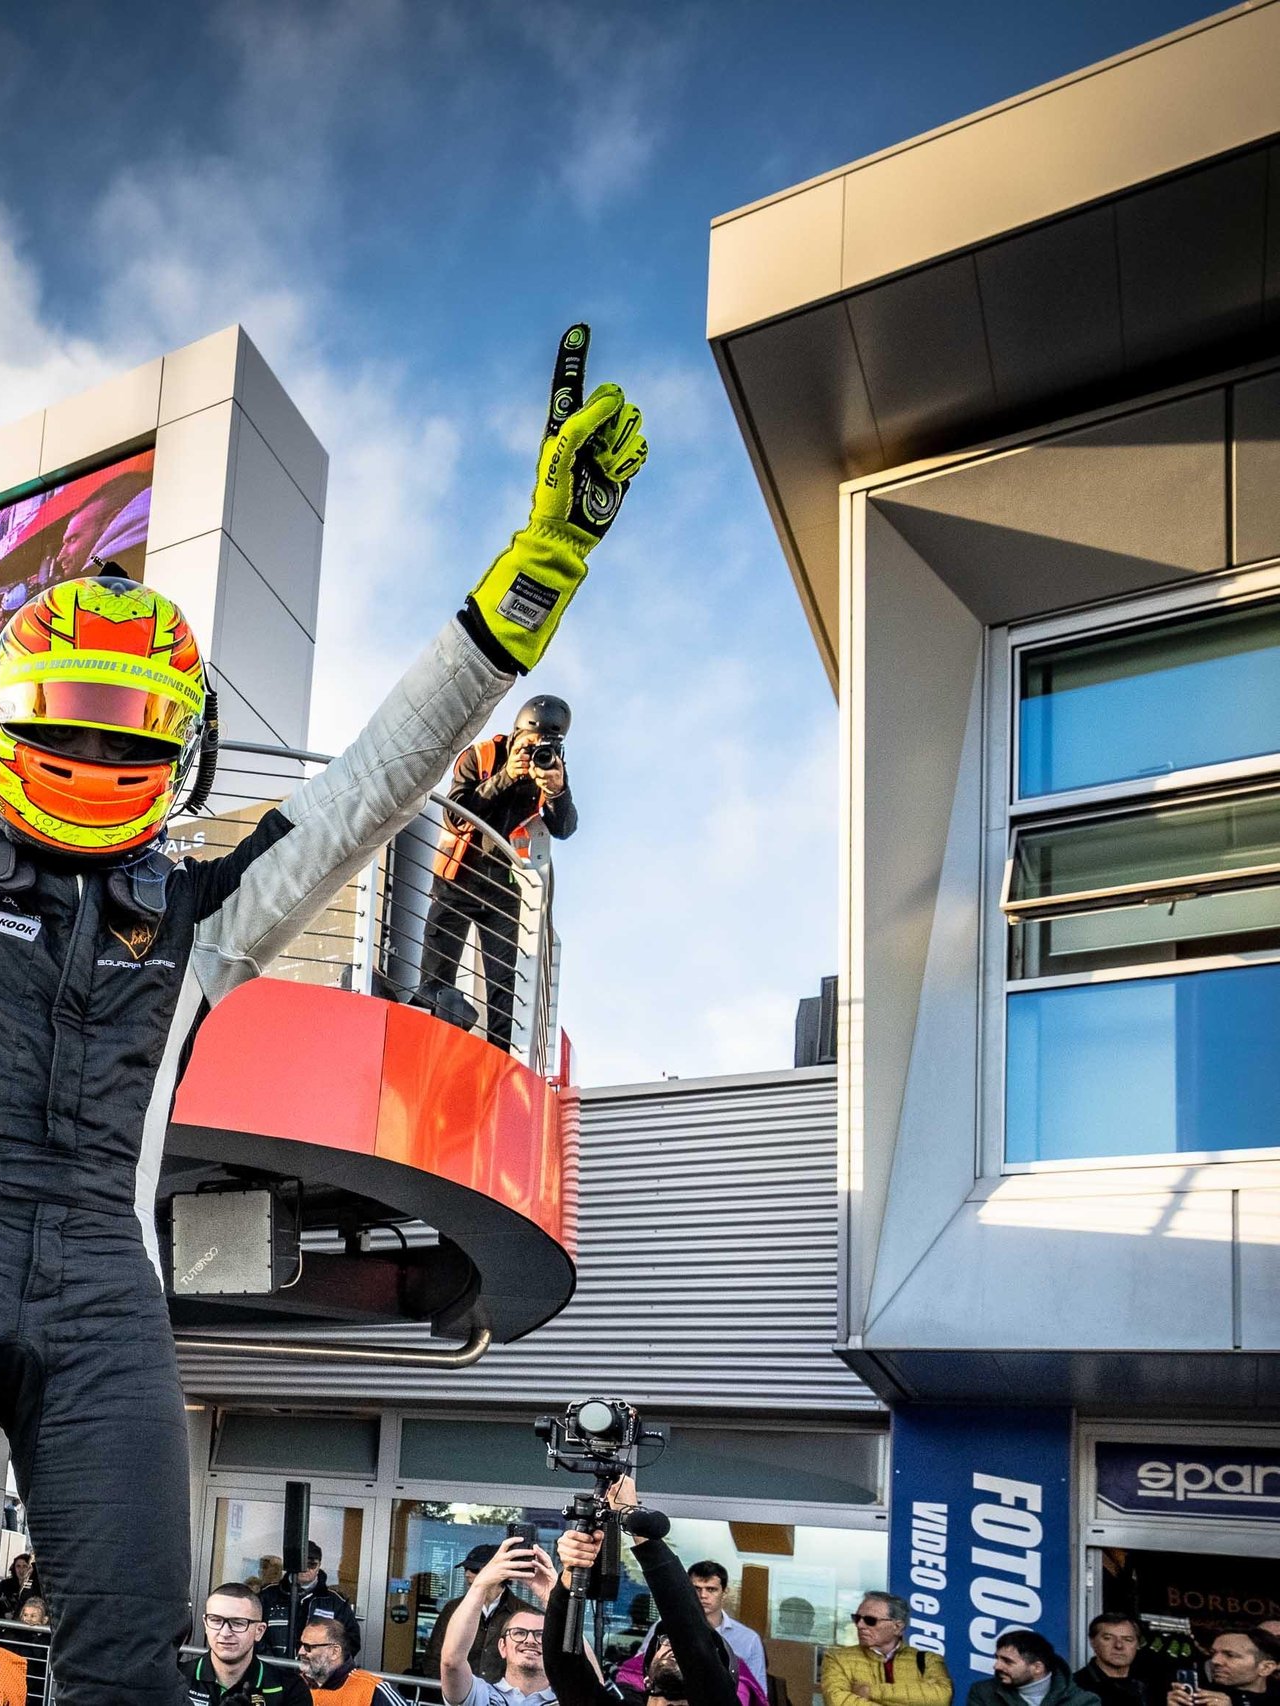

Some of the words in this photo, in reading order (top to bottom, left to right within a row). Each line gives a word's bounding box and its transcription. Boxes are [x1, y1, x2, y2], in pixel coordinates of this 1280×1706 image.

[1136, 1461, 1280, 1501] spar
[909, 1501, 948, 1590] VIDEO
[909, 1592, 940, 1616] e
